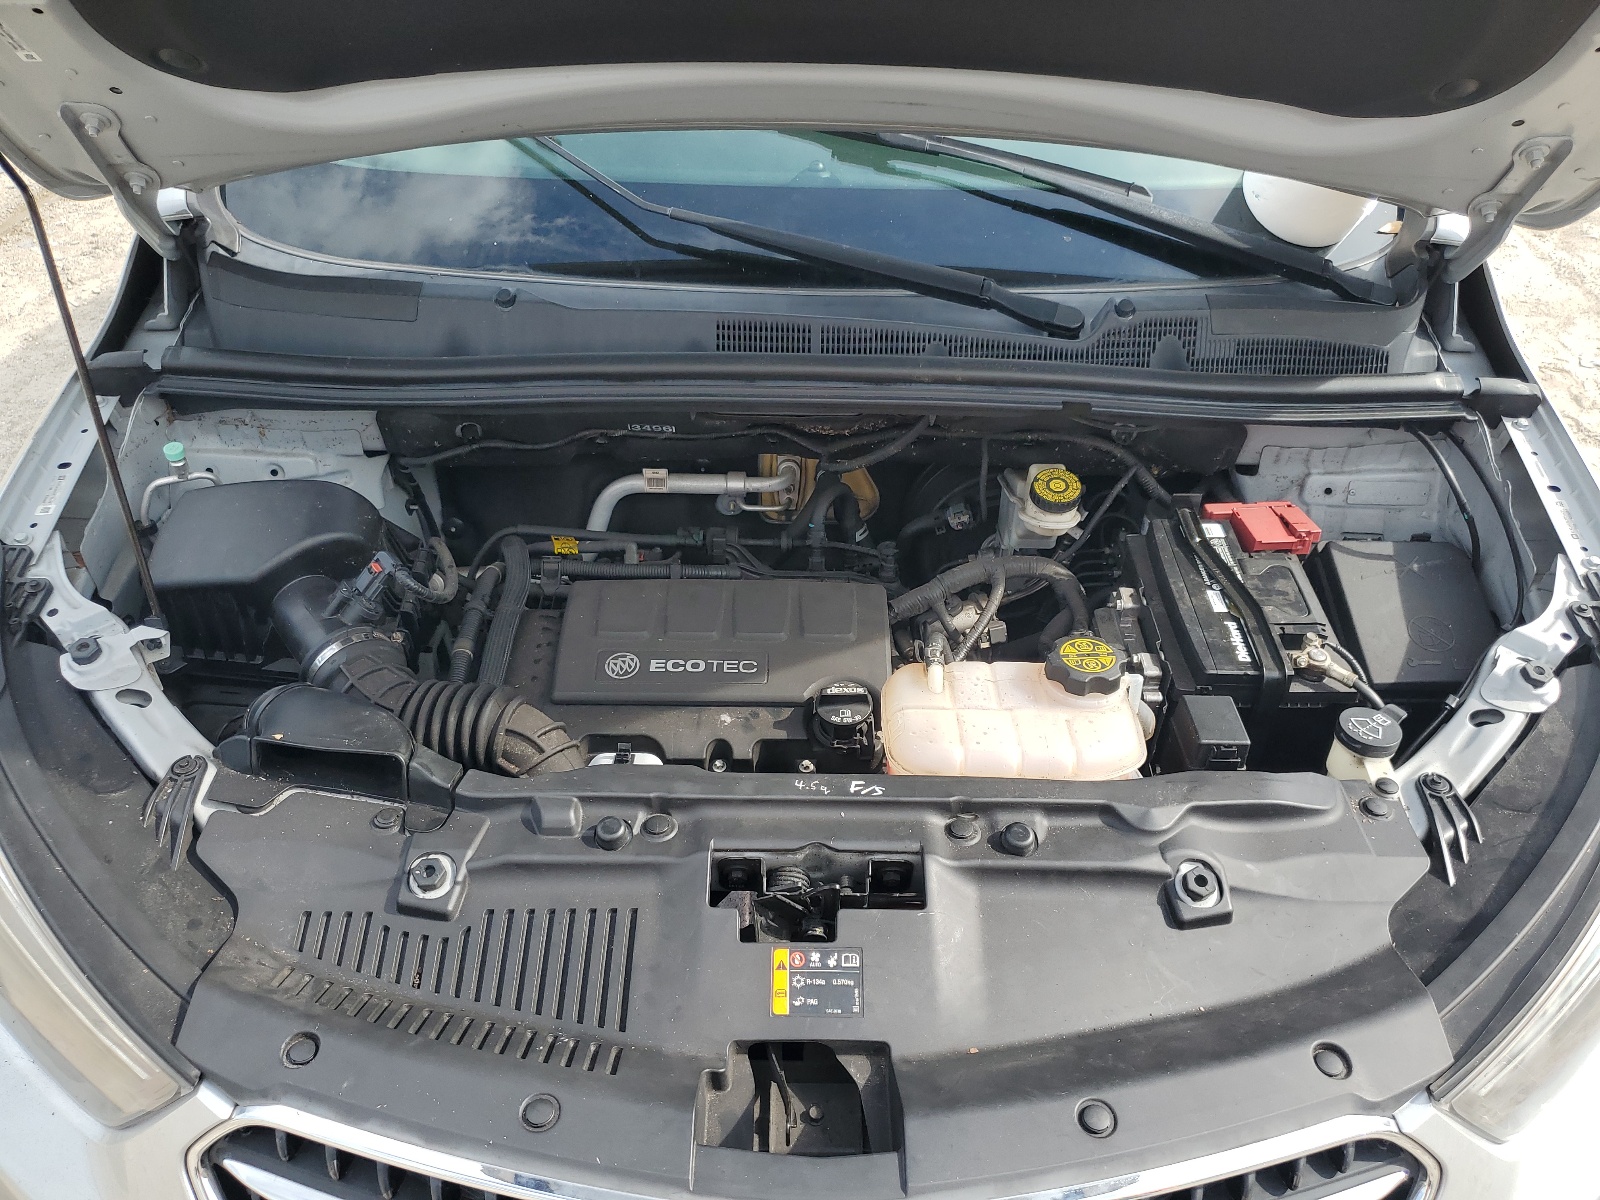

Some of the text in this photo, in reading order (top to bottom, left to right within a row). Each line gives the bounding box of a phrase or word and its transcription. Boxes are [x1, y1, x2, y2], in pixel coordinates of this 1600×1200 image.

[1223, 621, 1251, 662] DieHard
[650, 659, 758, 673] ECOTEC
[826, 686, 865, 694] dexos
